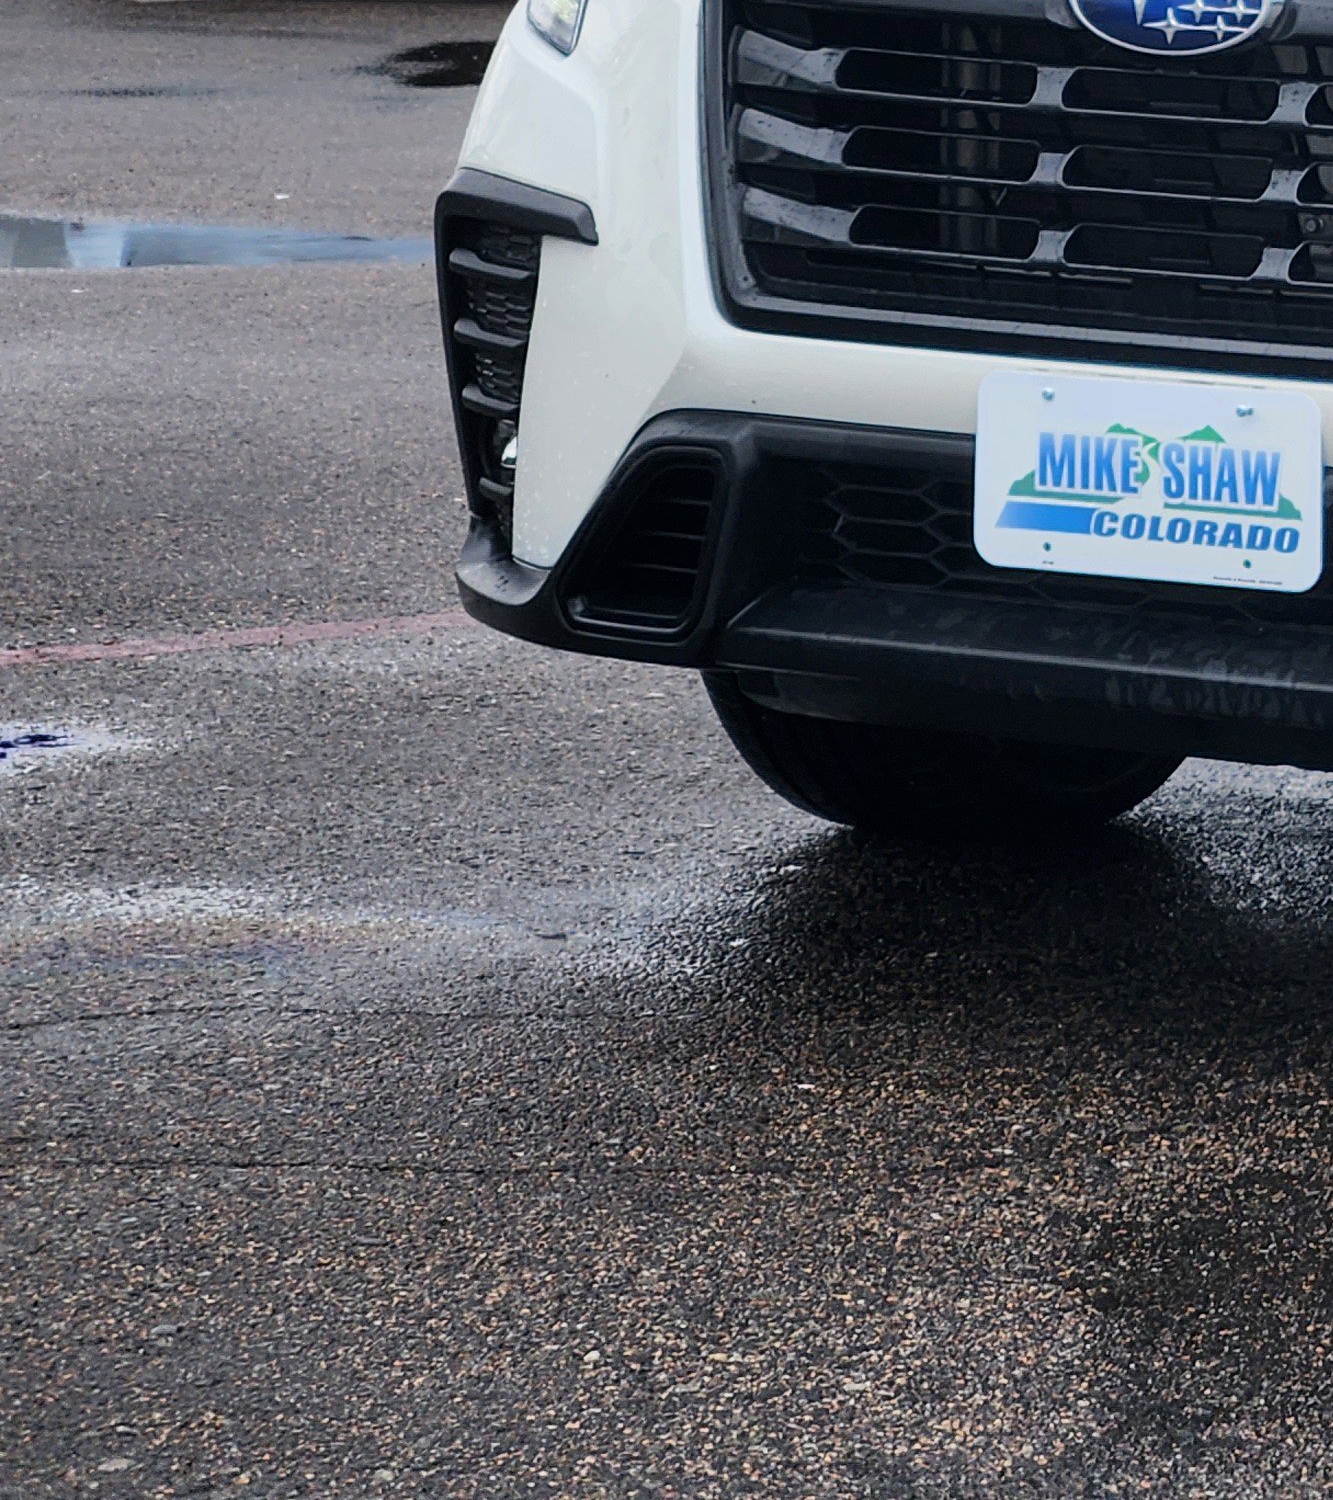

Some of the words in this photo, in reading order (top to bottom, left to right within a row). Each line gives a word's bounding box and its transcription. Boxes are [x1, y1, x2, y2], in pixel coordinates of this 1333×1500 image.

[1039, 431, 1140, 495] MIKE
[1162, 441, 1281, 507] SHAW
[1092, 512, 1300, 554] COLORADO
